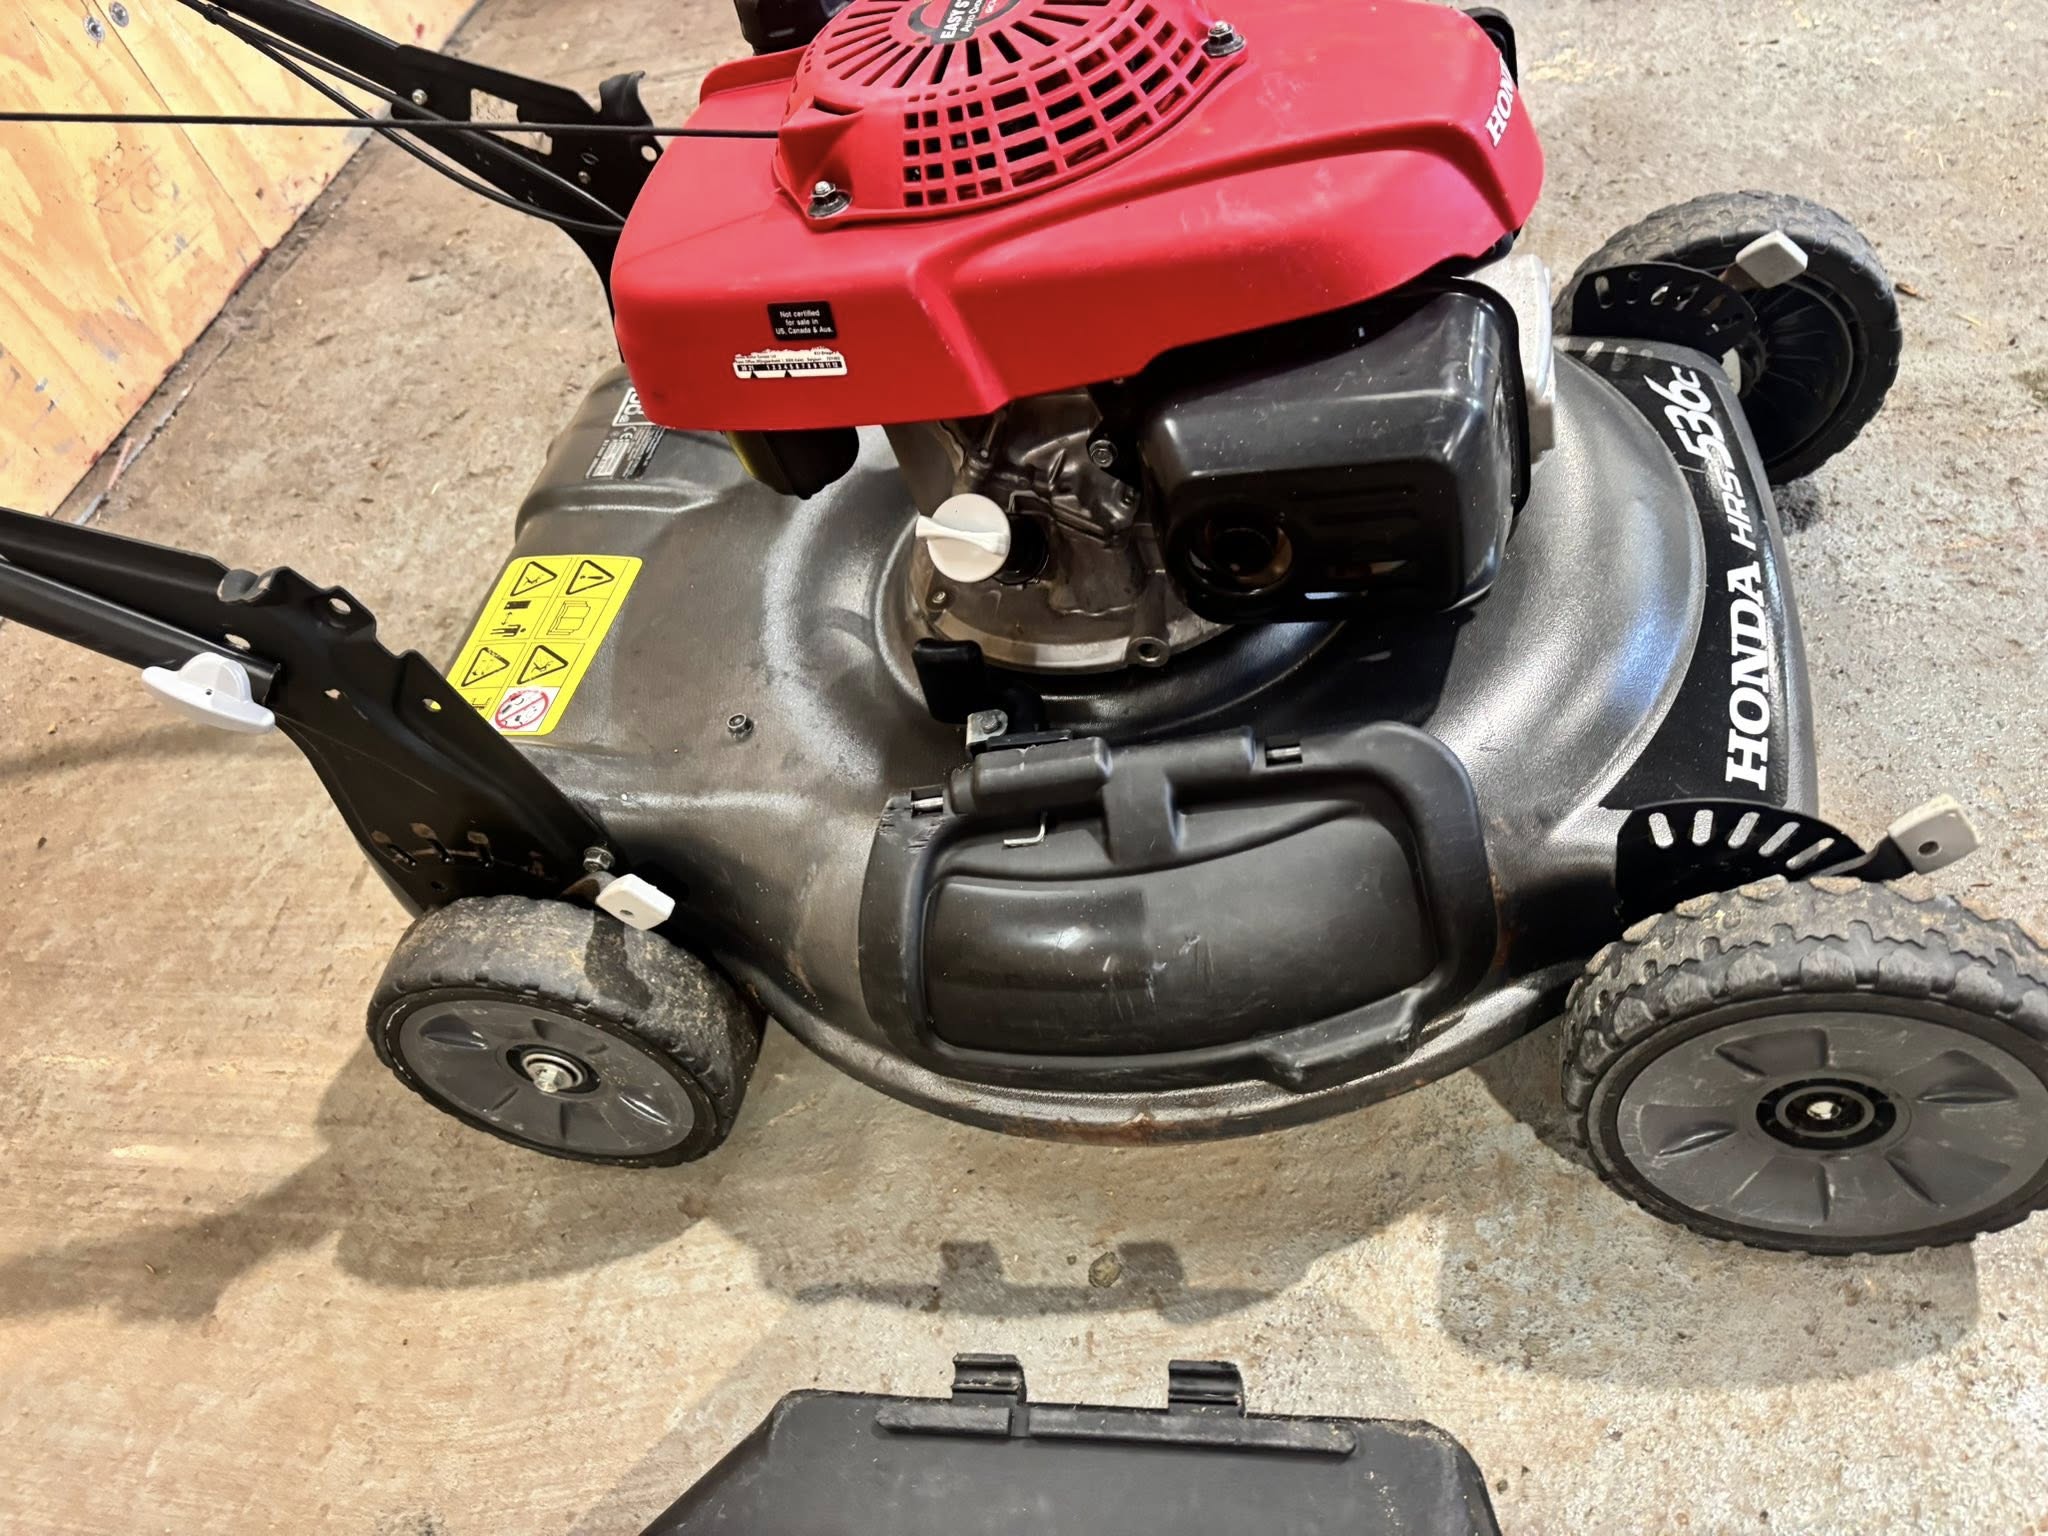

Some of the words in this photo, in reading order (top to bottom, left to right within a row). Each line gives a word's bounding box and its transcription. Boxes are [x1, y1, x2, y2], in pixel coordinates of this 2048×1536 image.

[940, 9, 966, 39] EASY
[780, 310, 791, 318] Not
[793, 309, 820, 318] certified
[796, 318, 810, 326] sale
[787, 326, 811, 335] Canada
[1715, 464, 1757, 551] HRS
[1725, 561, 1770, 791] HONDA
